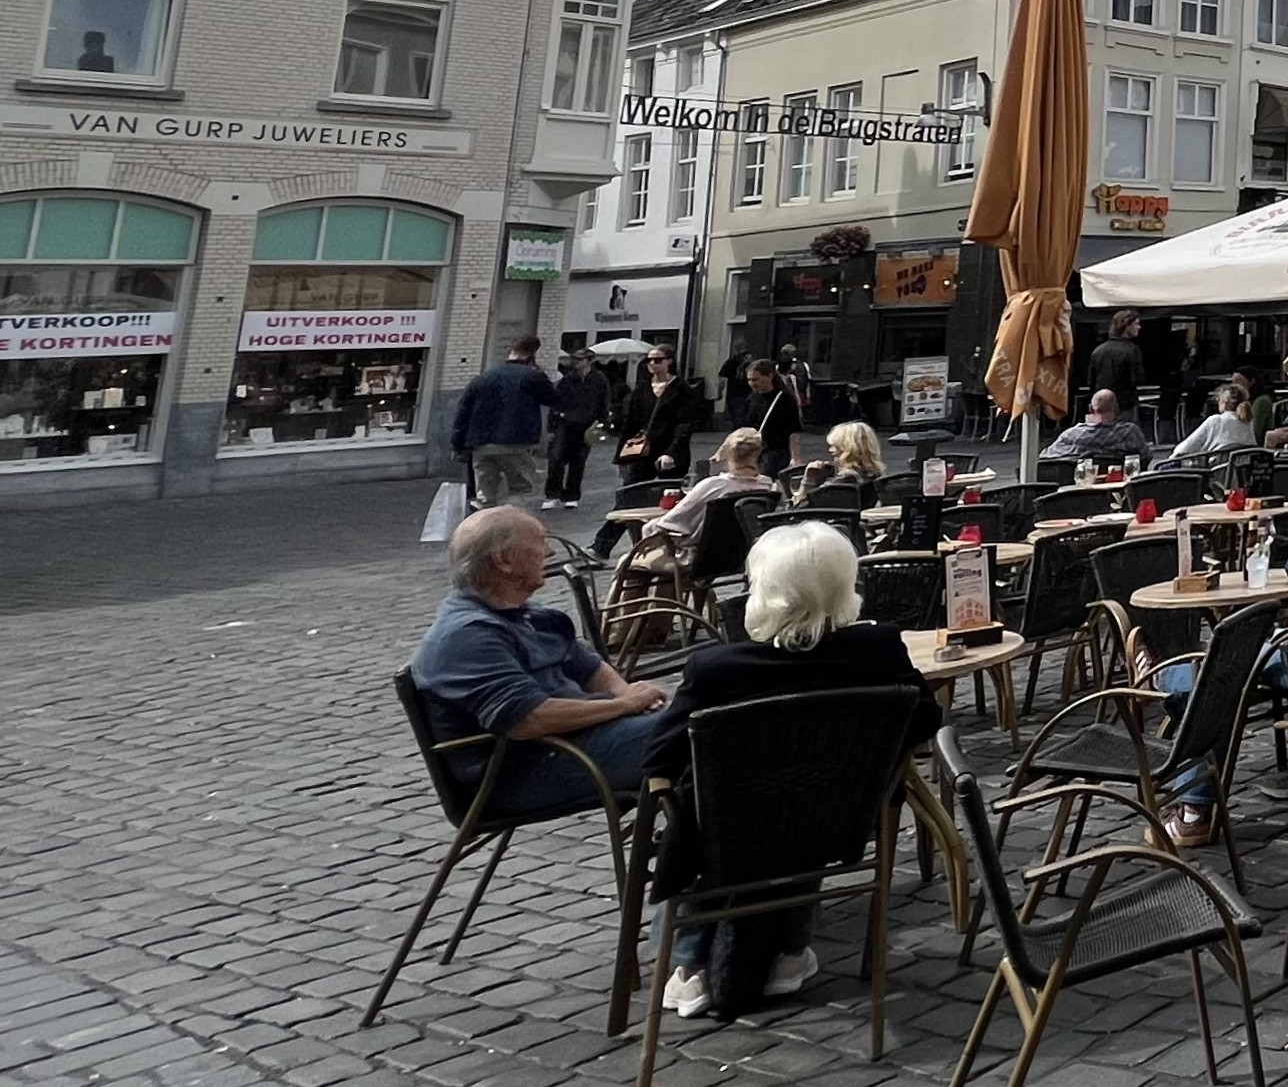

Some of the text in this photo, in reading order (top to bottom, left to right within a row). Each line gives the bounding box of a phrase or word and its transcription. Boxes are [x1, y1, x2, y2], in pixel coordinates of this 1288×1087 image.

[69, 113, 408, 149] VAN GURP JUWELIERS
[625, 95, 962, 145] Welkom in de Brugstraten
[1092, 183, 1168, 219] Happy
[266, 316, 416, 328] UITVERKOOP !!!
[20, 334, 172, 351] KORTINGEN
[249, 332, 426, 346] HOGE KORTINGEN
